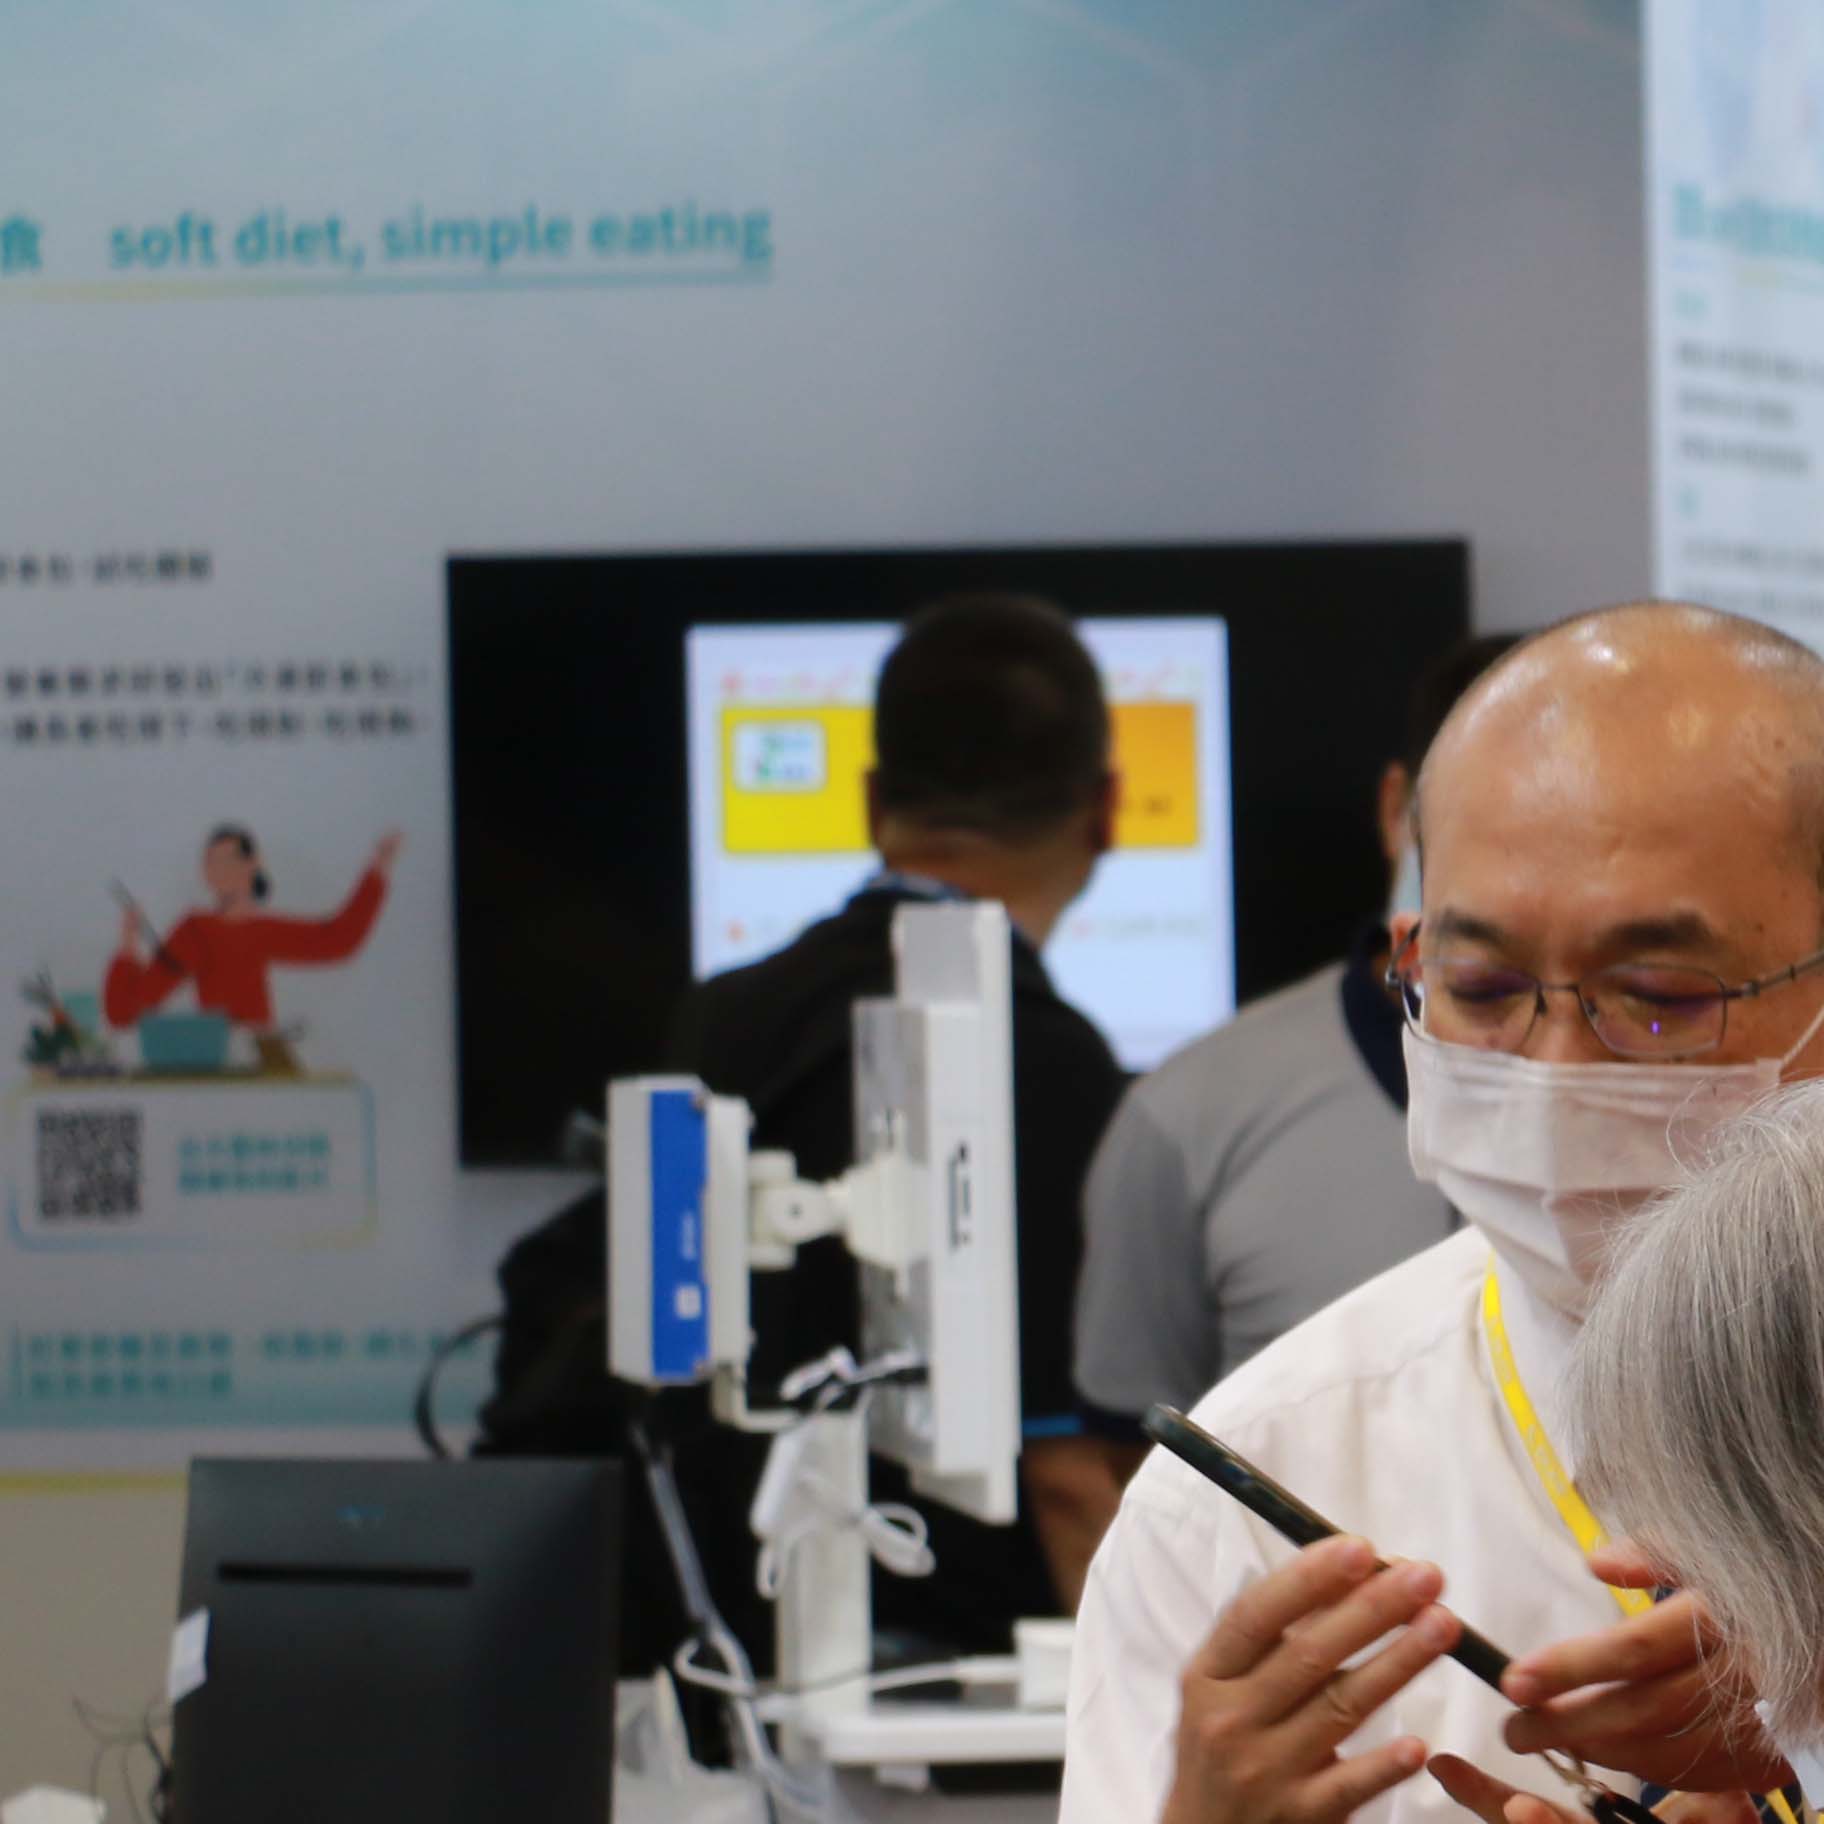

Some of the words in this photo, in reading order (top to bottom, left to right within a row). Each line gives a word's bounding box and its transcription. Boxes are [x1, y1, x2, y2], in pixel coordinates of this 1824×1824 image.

[110, 209, 216, 271] soft
[233, 205, 366, 274] diet,
[382, 201, 574, 267] simple
[589, 199, 773, 266] eating
